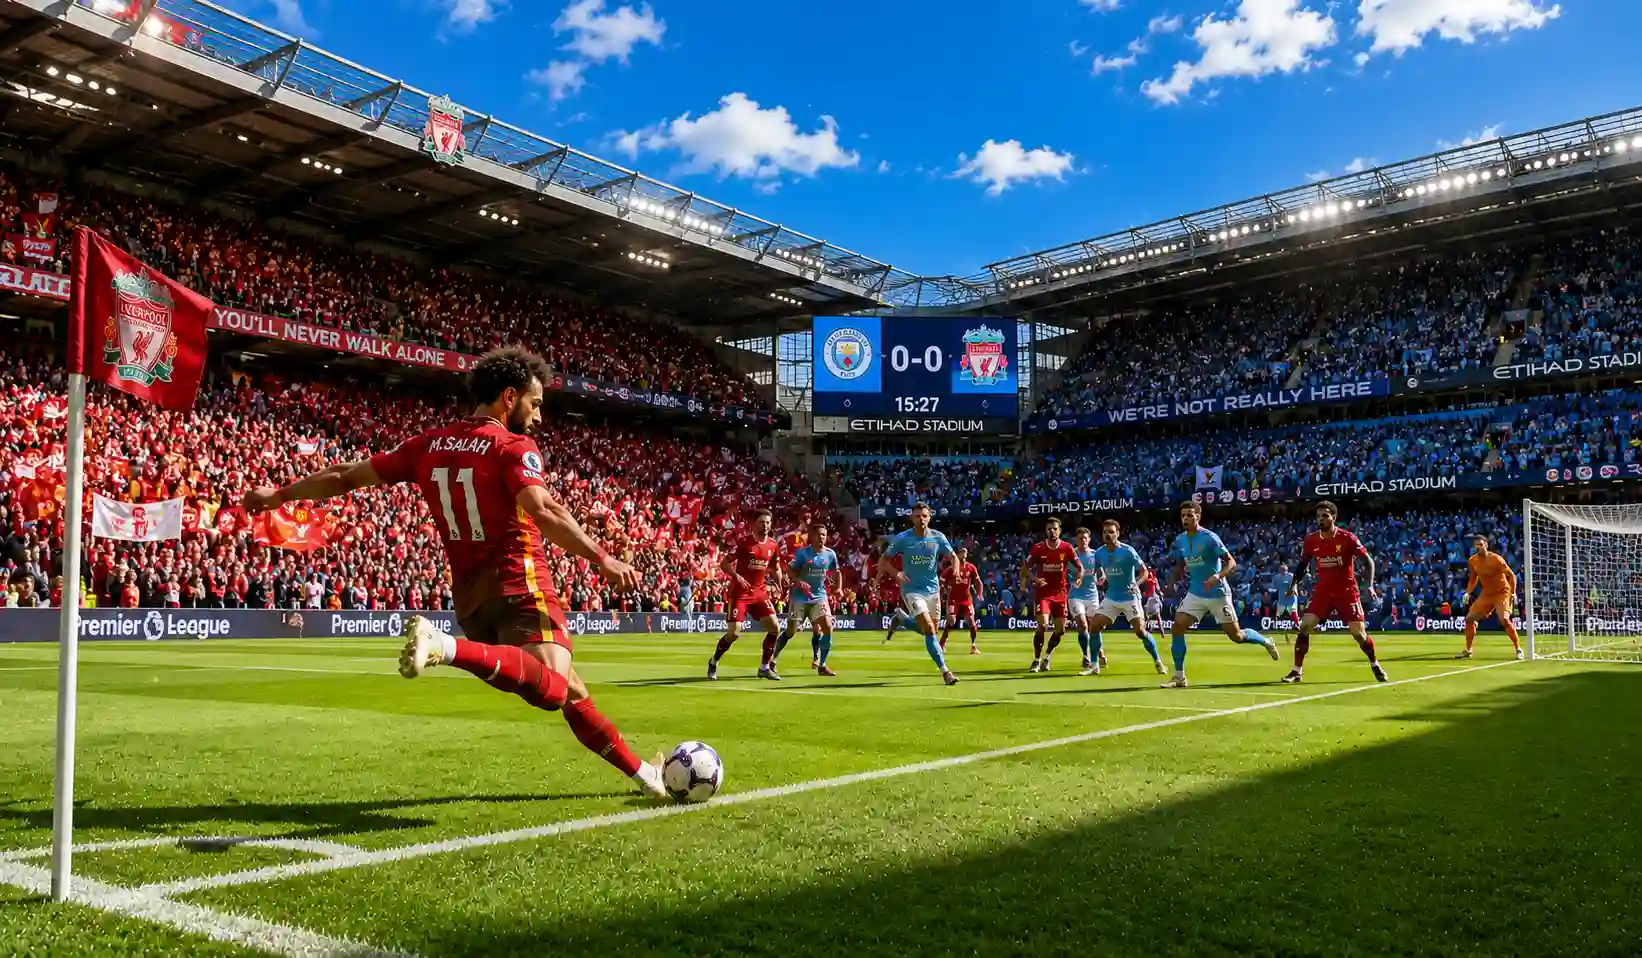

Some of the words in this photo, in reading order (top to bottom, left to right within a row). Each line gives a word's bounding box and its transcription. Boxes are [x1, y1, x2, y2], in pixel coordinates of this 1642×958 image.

[214, 308, 279, 337] YOU'LL
[283, 322, 341, 349] NEVER
[346, 334, 395, 358] WALK
[396, 346, 446, 367] ALONE
[890, 344, 943, 373] 0-0
[1493, 357, 1583, 380] ETIHAD
[895, 396, 940, 413] 15:27
[1107, 403, 1169, 423] WE'RE
[1174, 398, 1217, 416] NOT
[1223, 387, 1304, 411] REALLY
[1310, 381, 1373, 401] HERE
[850, 418, 919, 432] ETIHAD
[923, 419, 984, 432] STADIUM
[1314, 480, 1385, 496] ETIHAD
[1388, 475, 1457, 492] STADIUM
[430, 467, 486, 542] 11
[1027, 501, 1081, 515] ETIHAD
[1083, 497, 1134, 512] STADIUM
[166, 613, 231, 639] League
[331, 612, 388, 634] Premier
